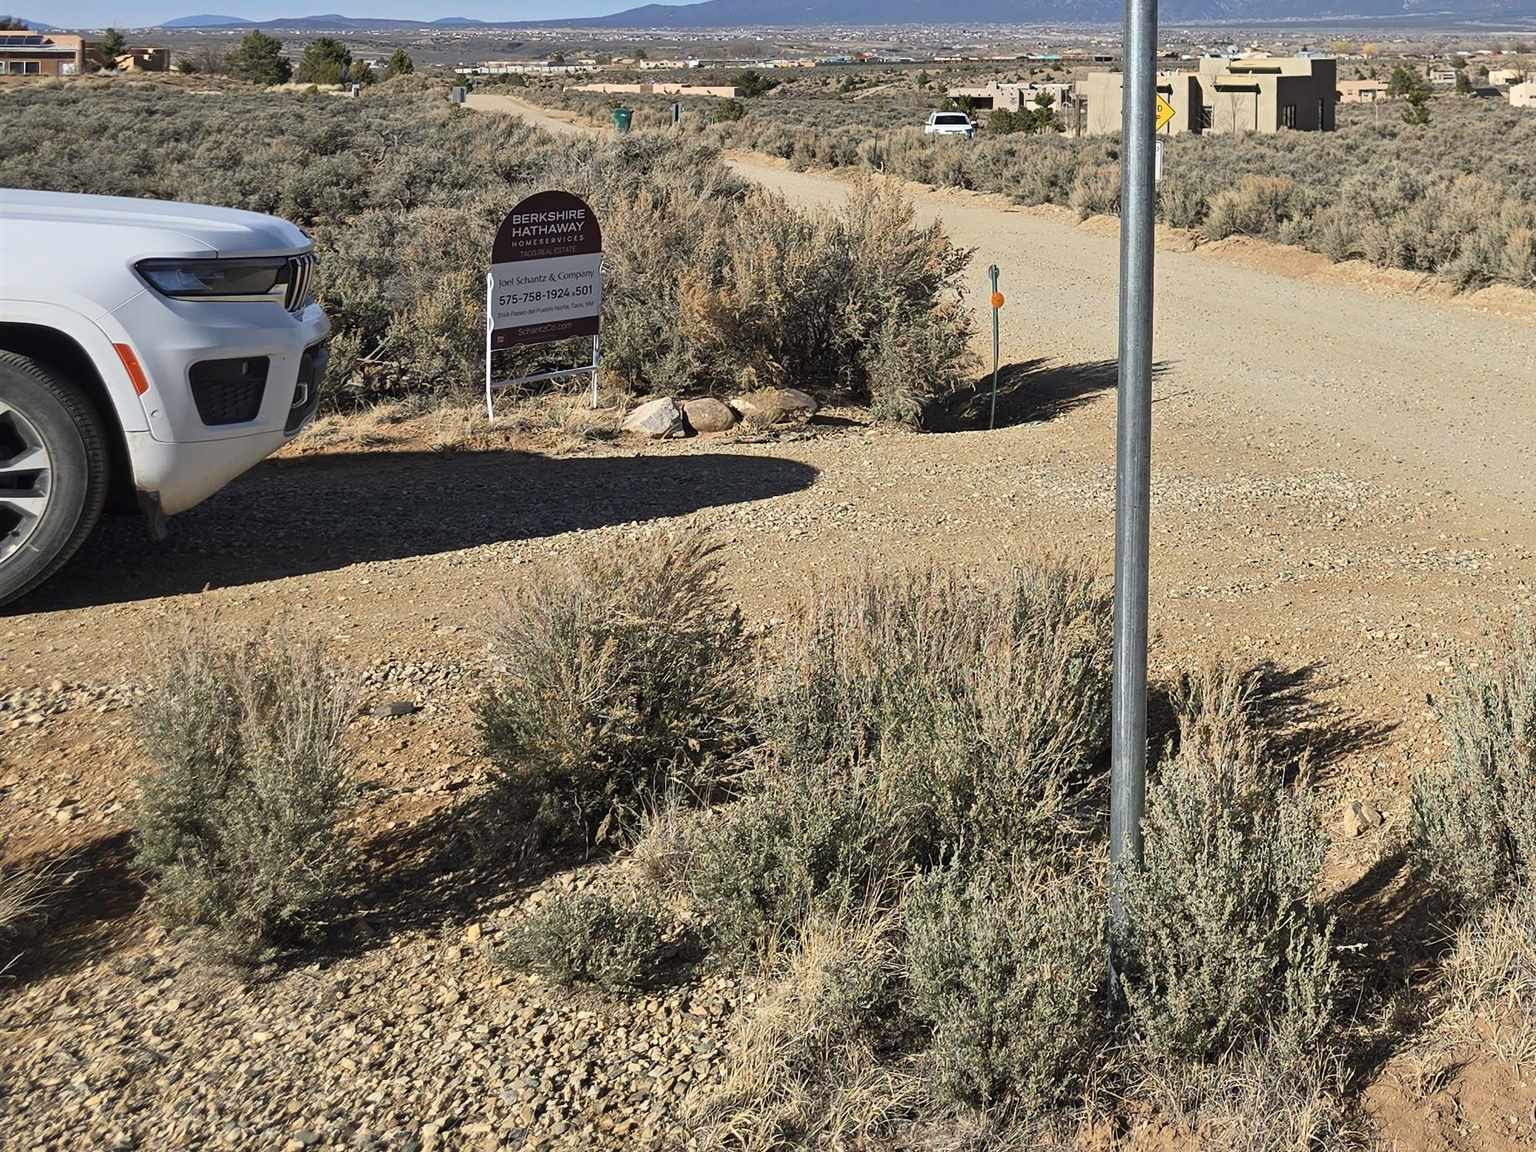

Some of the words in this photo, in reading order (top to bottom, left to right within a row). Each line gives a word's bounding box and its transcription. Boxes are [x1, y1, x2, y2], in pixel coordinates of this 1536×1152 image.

[512, 209, 585, 225] BERKSHIRE
[512, 221, 585, 238] HATHAWAY
[512, 235, 585, 247] HOMESERVICES
[548, 272, 557, 282] &
[557, 270, 594, 282] Company
